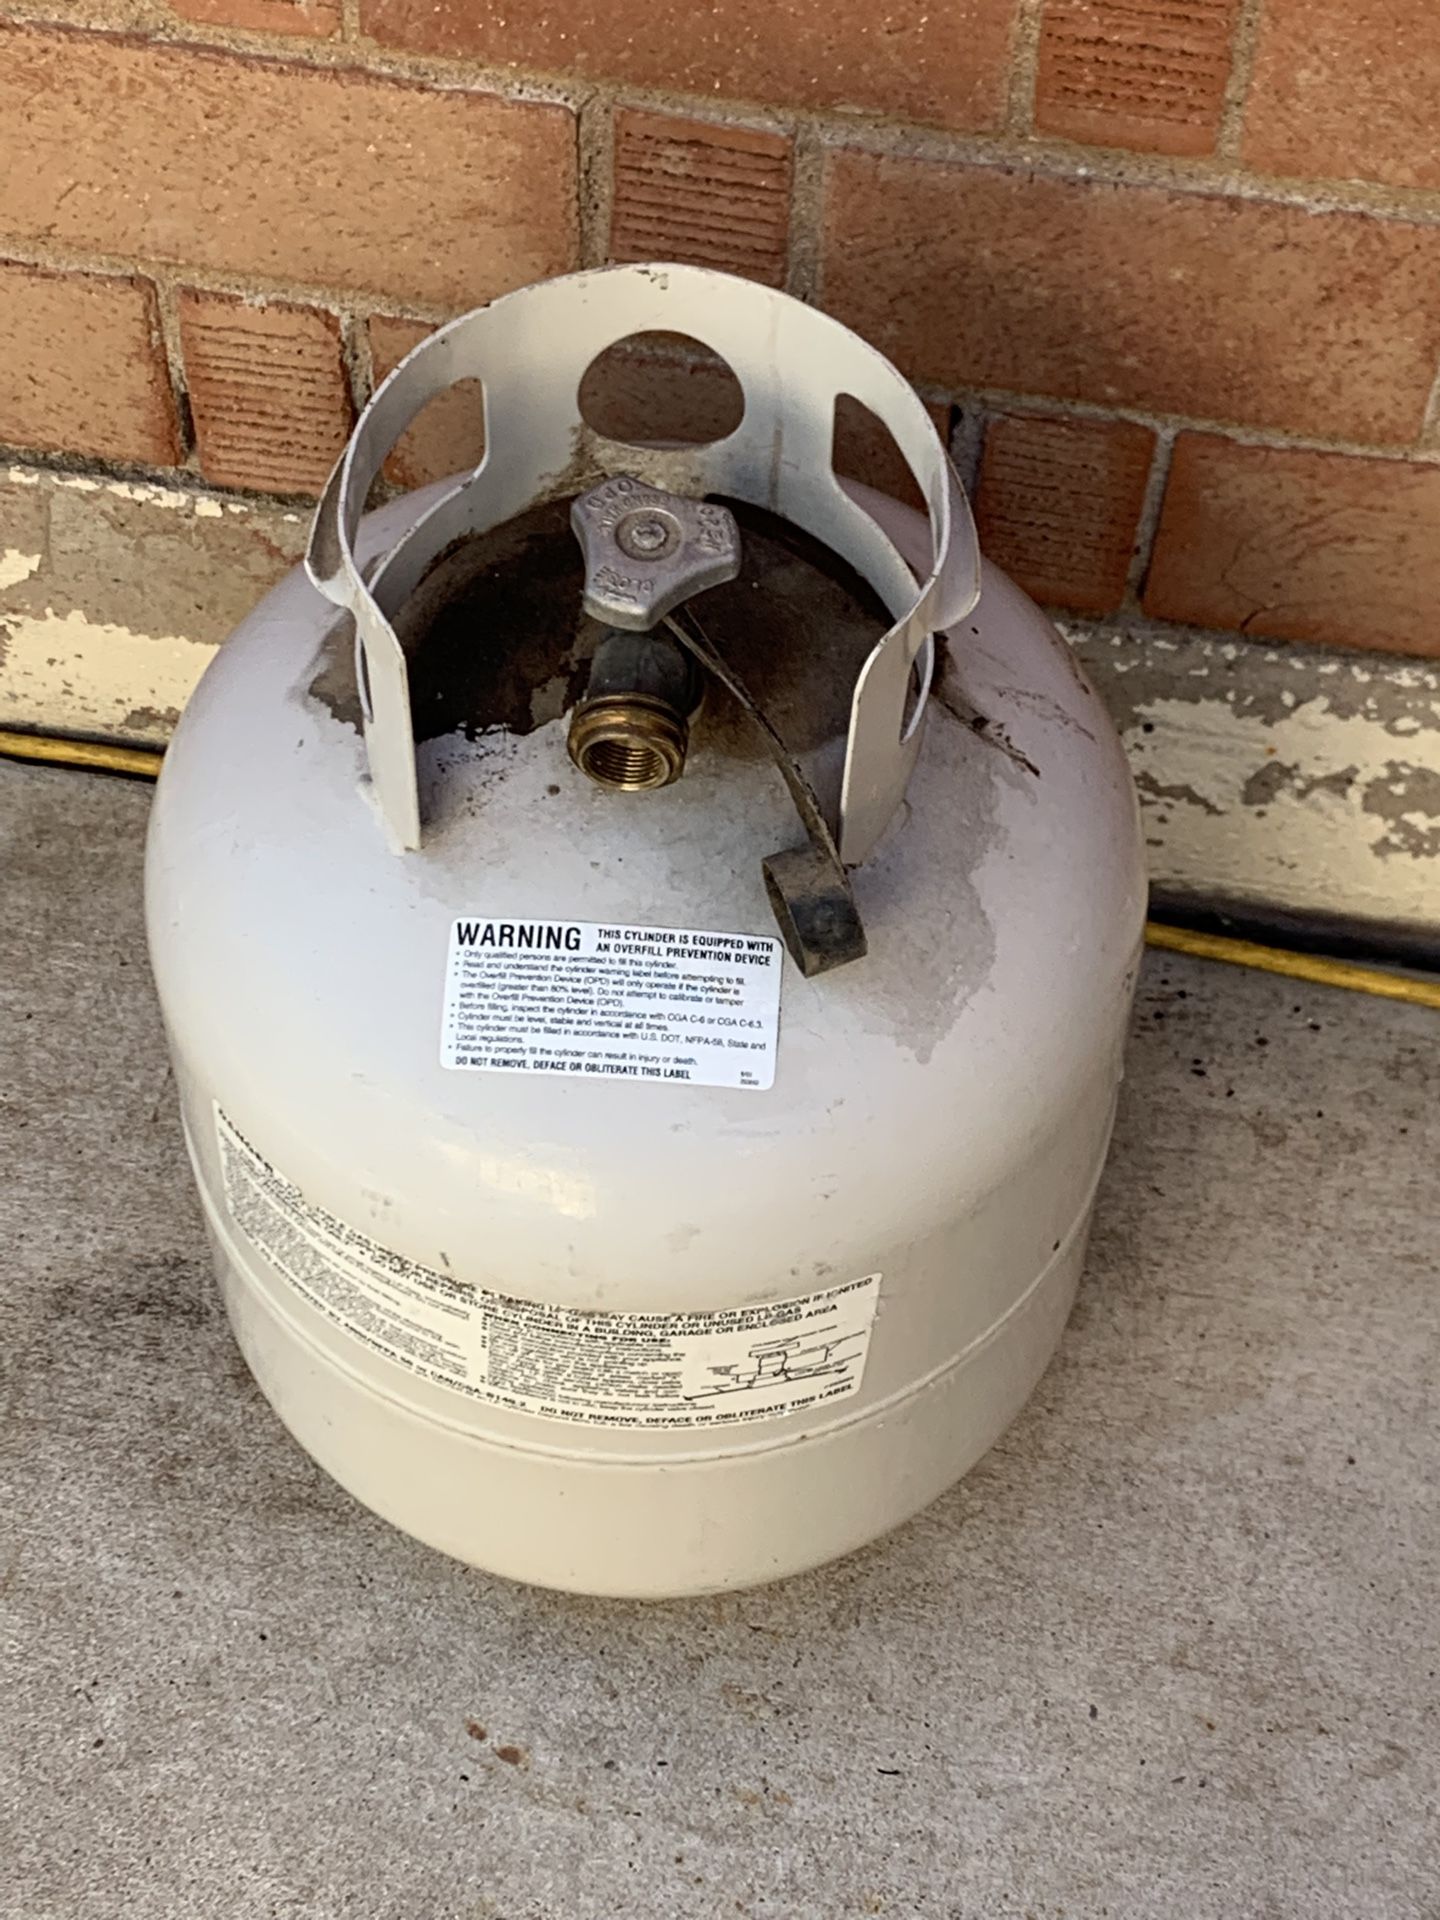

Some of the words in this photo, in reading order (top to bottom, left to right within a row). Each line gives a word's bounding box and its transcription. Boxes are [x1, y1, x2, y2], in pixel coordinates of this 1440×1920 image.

[586, 479, 633, 510] OPD
[456, 922, 580, 950] WARNING
[597, 928, 620, 939] THIS
[624, 930, 675, 943] CYLINDER
[678, 934, 688, 944] IS
[692, 935, 744, 949] EQUIPPED
[746, 940, 773, 952] WITH
[463, 949, 482, 959] Only
[483, 951, 517, 959] qualified
[518, 953, 551, 961] persons
[568, 956, 606, 964] permitted
[628, 958, 642, 966] this
[596, 942, 610, 951] AN
[613, 943, 662, 956] OVERFILL
[666, 946, 731, 961] PREVENTION
[734, 952, 770, 966] DEVICE
[462, 959, 484, 968] Read
[503, 963, 548, 971] understand
[564, 965, 596, 973] cylinder
[598, 968, 630, 977] warning
[632, 969, 651, 977] label
[653, 970, 679, 979] before
[681, 973, 724, 985] attempting
[462, 969, 477, 978] The
[479, 970, 506, 979] Overfill
[509, 972, 551, 981] Prevention
[553, 974, 581, 983] Device
[583, 976, 609, 985] (OPD)
[626, 979, 643, 988] only
[685, 983, 698, 991] the
[699, 985, 731, 994] cylinder
[460, 981, 495, 989] overfilled
[530, 983, 548, 991] than
[596, 987, 609, 995] Do
[626, 990, 656, 999] attempt
[668, 993, 703, 1002] calibrate
[715, 996, 743, 1006] tamper
[491, 992, 519, 1000] Overfill
[521, 993, 564, 1003] Prevention
[566, 996, 594, 1004] Device
[457, 1011, 490, 1020] Cylinder
[634, 1021, 643, 1029] all
[458, 1001, 485, 1010] Before
[556, 1006, 588, 1015] cylinder
[599, 1010, 646, 1019] accordance
[649, 1012, 665, 1020] with
[689, 1014, 705, 1023] C-6
[455, 1033, 477, 1041] Local
[457, 1021, 474, 1030] This
[476, 1023, 506, 1031] cylinder
[543, 1026, 561, 1034] filled
[572, 1030, 620, 1038] accordance
[640, 1032, 657, 1041] U.S.
[727, 1038, 748, 1048] State
[455, 1042, 482, 1051] Failure
[494, 1046, 526, 1055] properly
[528, 1046, 537, 1054] fill
[539, 1047, 552, 1055] the
[553, 1048, 585, 1057] cylinder
[637, 1054, 660, 1063] injury
[455, 1055, 467, 1065] DO
[470, 1057, 487, 1065] NOT
[490, 1057, 530, 1068] REMOVE,
[533, 1060, 566, 1070] DEFACE
[568, 1061, 582, 1071] OR
[584, 1062, 637, 1075] OBLITERATE
[641, 1066, 661, 1076] THIS
[663, 1068, 690, 1079] LABEL
[628, 1313, 673, 1323] CAUSE
[676, 1313, 684, 1322] A
[688, 1312, 715, 1321] FIRE
[719, 1310, 737, 1319] OR
[740, 1296, 810, 1317] EXPLOSION
[812, 1293, 824, 1302] IF
[826, 1277, 873, 1299] IGNITED
[459, 1294, 499, 1314] STORE
[502, 1308, 563, 1329] CYLINDER
[566, 1322, 579, 1331] IN
[582, 1324, 591, 1332] A
[659, 1327, 712, 1337] GARAGE
[715, 1324, 734, 1335] OR
[737, 1314, 803, 1332] ENCLOSED
[805, 1304, 838, 1319] AREA
[484, 1312, 519, 1325] WHEN
[523, 1322, 607, 1341] CONNECTING
[611, 1335, 637, 1343] FOR
[565, 1316, 582, 1325] OF
[586, 1318, 612, 1328] THIS
[616, 1319, 684, 1330] CYLINDER
[685, 1321, 700, 1329] OR
[703, 1315, 754, 1328] UNUSED
[540, 1405, 557, 1414] DO
[560, 1409, 584, 1419] NOT
[588, 1413, 642, 1425] REMOVE,
[646, 1416, 690, 1424] DEFACE
[695, 1414, 713, 1422] OR
[715, 1403, 785, 1421] OBLITERATE
[790, 1395, 816, 1407] THIS
[819, 1384, 853, 1399] LABEL
